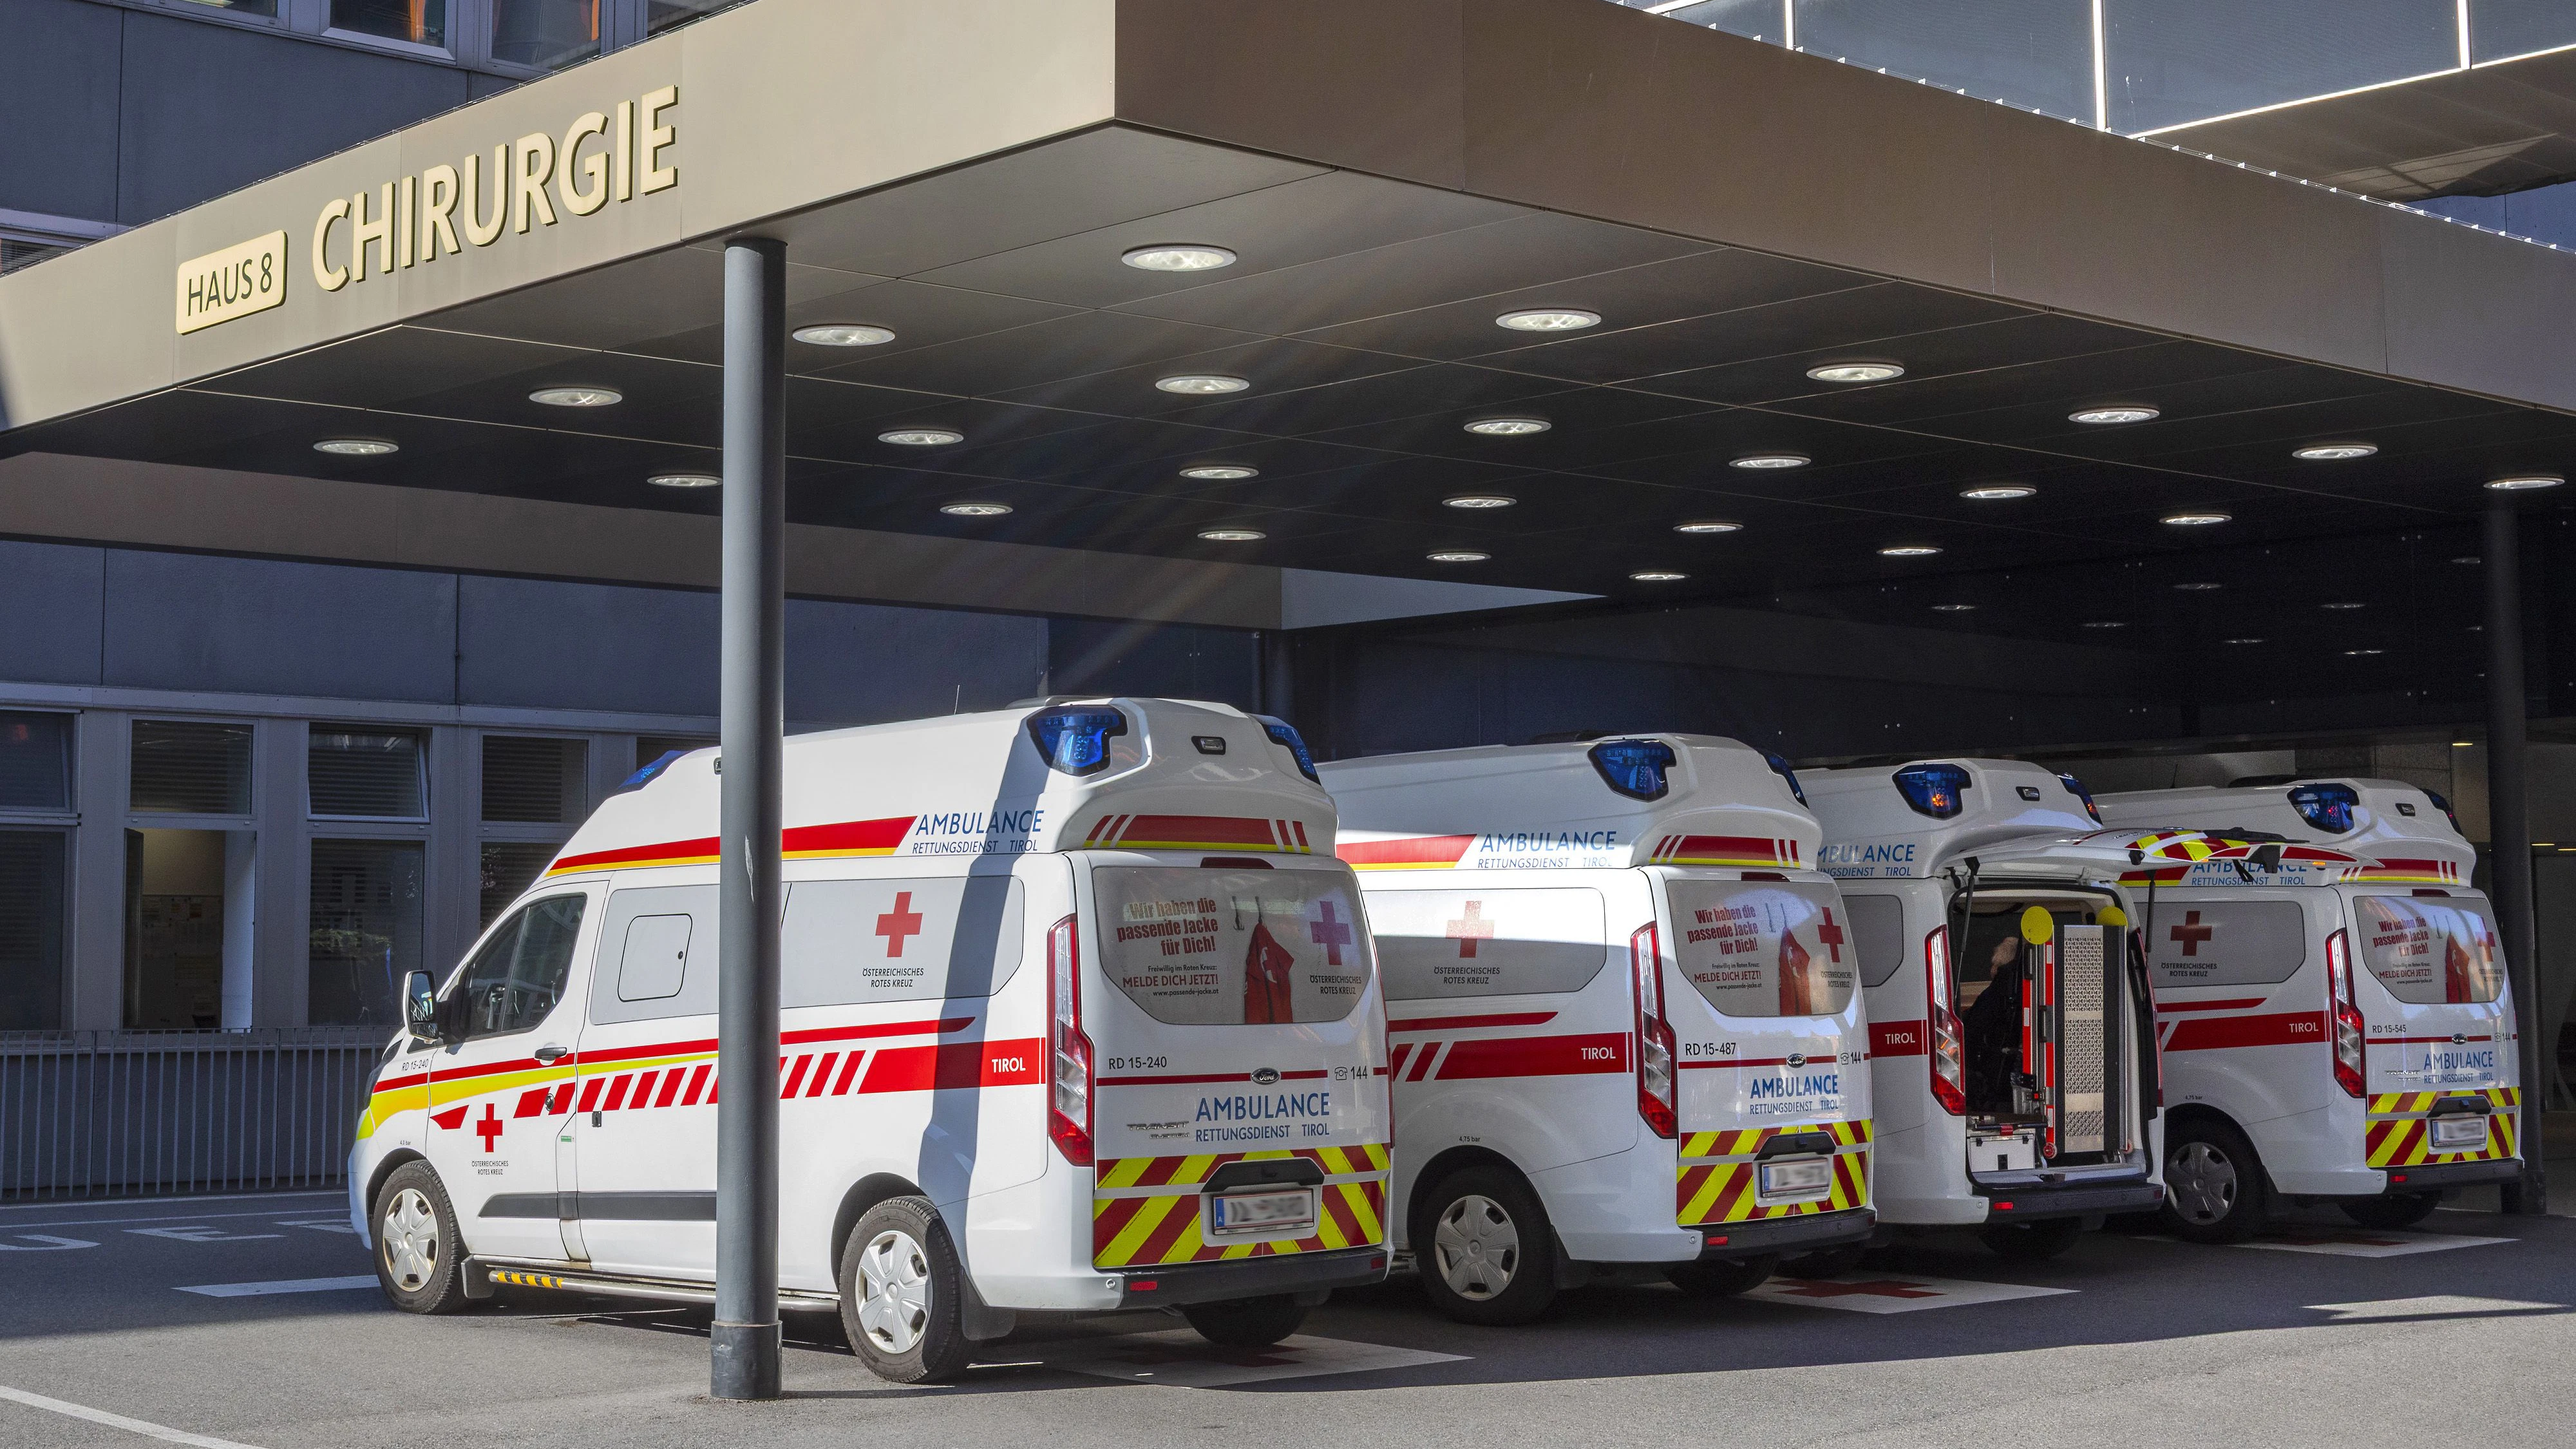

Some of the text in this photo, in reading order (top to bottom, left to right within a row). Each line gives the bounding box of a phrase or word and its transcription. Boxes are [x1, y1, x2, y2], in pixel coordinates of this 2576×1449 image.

[312, 84, 679, 292] CHIRURGIE
[187, 252, 272, 316] HAUS 8
[915, 810, 1045, 836] AMBULANCE
[912, 839, 1038, 854] RETTUNGSDIENST TIROL
[1480, 831, 1617, 853] AMBULANCE
[1817, 844, 1915, 863] MBULANCE
[1478, 857, 1569, 869] RETTUNGSDIENST
[1885, 867, 1911, 876] TIROL
[2280, 876, 2306, 885] TIROL
[1130, 897, 1217, 920] Wir haben die
[1695, 905, 1756, 923] Wir haben die
[1117, 917, 1218, 942] passende Jacke
[2378, 916, 2427, 933] Wir haben die
[1687, 922, 1759, 943] passende Jacke
[2372, 930, 2429, 948] passende Jacke
[1161, 936, 1216, 956] für Dich!
[1720, 938, 1758, 955] für Dich!
[2398, 943, 2429, 957] für Dich!
[862, 967, 924, 977] ÖSTERREICHISCHES
[1434, 966, 1501, 974] ÖSTERREICHISCHES
[1694, 971, 1761, 983] MELDE DICH JETZT!
[2379, 971, 2400, 979] MELDE
[2416, 969, 2432, 977] JETZT!
[871, 979, 913, 988] ROTES KREUZ
[1122, 974, 1218, 988] MELDE DICH JETZT!
[1309, 974, 1362, 984] ÖSTERREICHISCHES
[1153, 988, 1218, 997] www.passende-jacke.at
[1320, 986, 1338, 994] ROTES
[2289, 1022, 2318, 1033] TIROL
[2384, 1025, 2407, 1033] 15-545
[1885, 1032, 1916, 1045] TIROL
[2502, 1032, 2510, 1042] 144
[1581, 1047, 1616, 1060] TIROL
[1685, 1043, 1736, 1056] RD 15-487
[401, 1058, 429, 1072] RD 15-240
[991, 1057, 1026, 1073] TIROL
[1108, 1056, 1168, 1070] RD 15-240
[1850, 1052, 1861, 1064] 144
[2423, 1051, 2494, 1070] AMBULANCE
[1350, 1066, 1367, 1079] 144
[2424, 1073, 2474, 1084] RETTUNGSDIENST
[2479, 1072, 2494, 1081] TIROL
[1750, 1075, 1839, 1099] AMBULANCE
[1195, 1093, 1330, 1122] AMBULANCE
[1750, 1099, 1839, 1115] RETTUNGSDIENST TIROL
[1126, 1121, 1189, 1130] TRANSIT
[1196, 1123, 1330, 1142] RETTUNGSDIENST TIROL
